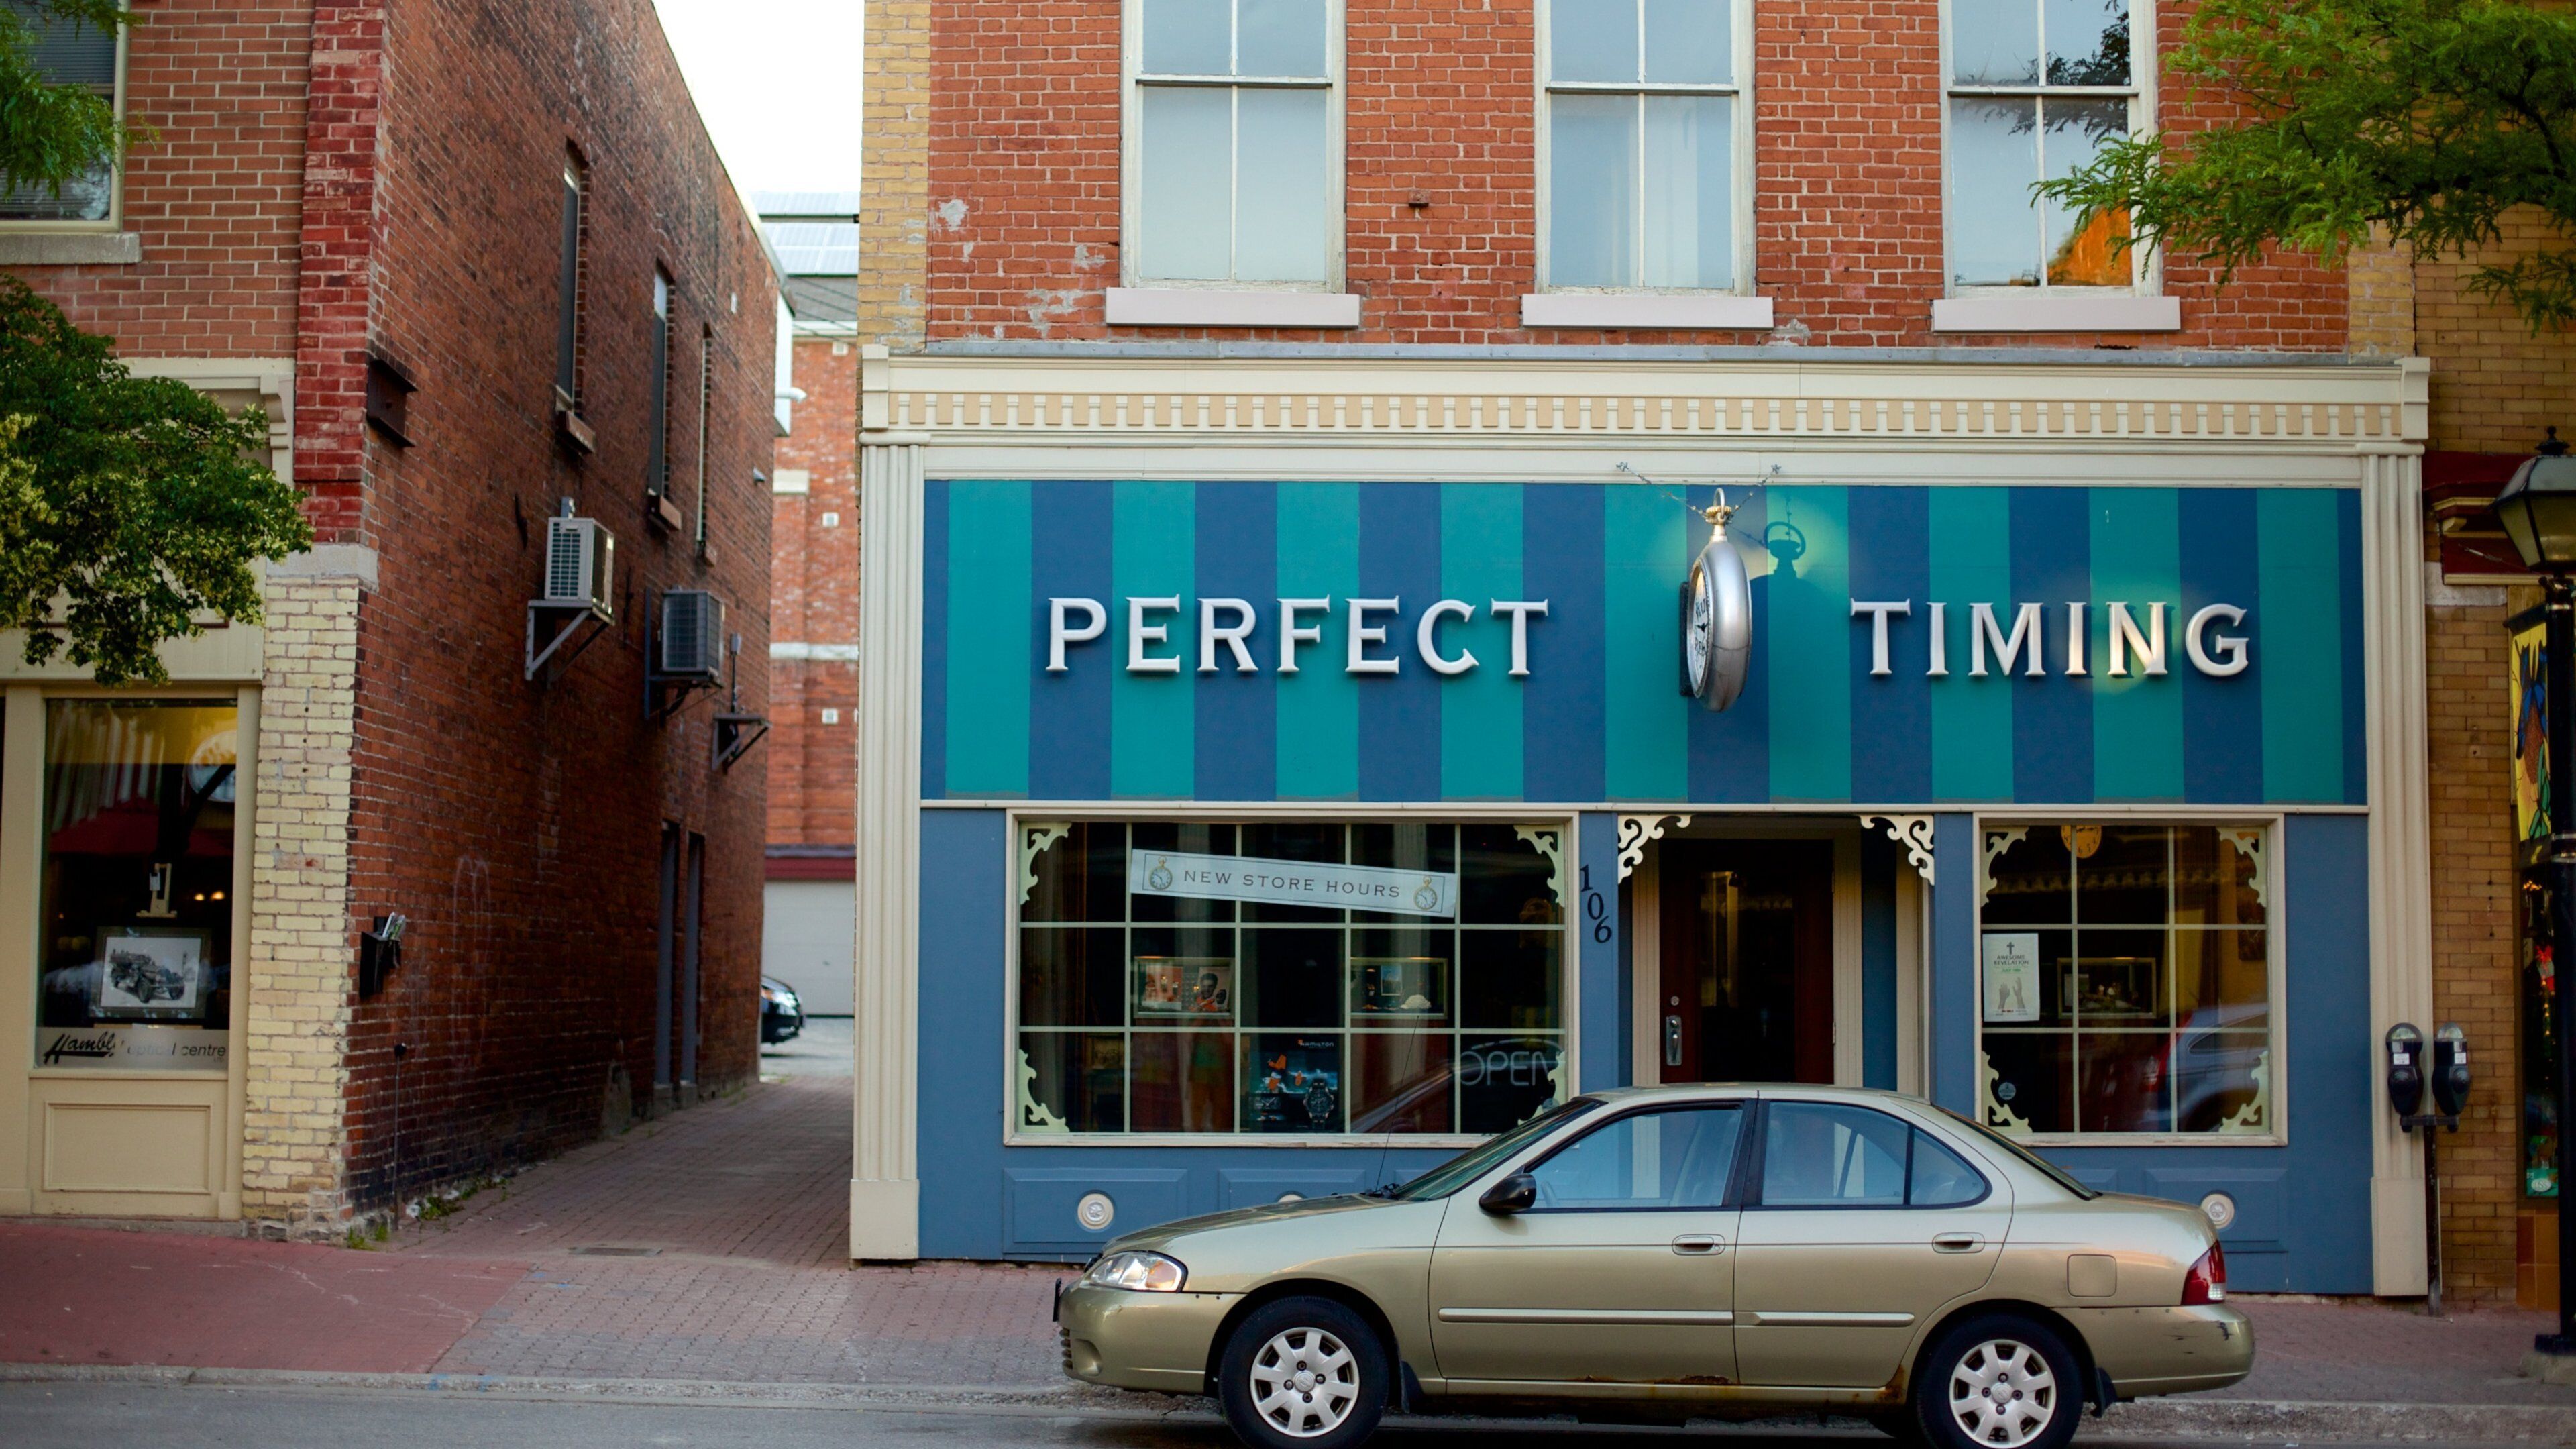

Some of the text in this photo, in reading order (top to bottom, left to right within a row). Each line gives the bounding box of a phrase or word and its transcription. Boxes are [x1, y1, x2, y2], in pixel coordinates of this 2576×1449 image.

[1045, 594, 2249, 677] PERFECT TIMING
[1183, 870, 1401, 898] NEW STORE HOURS
[1580, 864, 1612, 943] 106
[182, 1042, 226, 1057] centre
